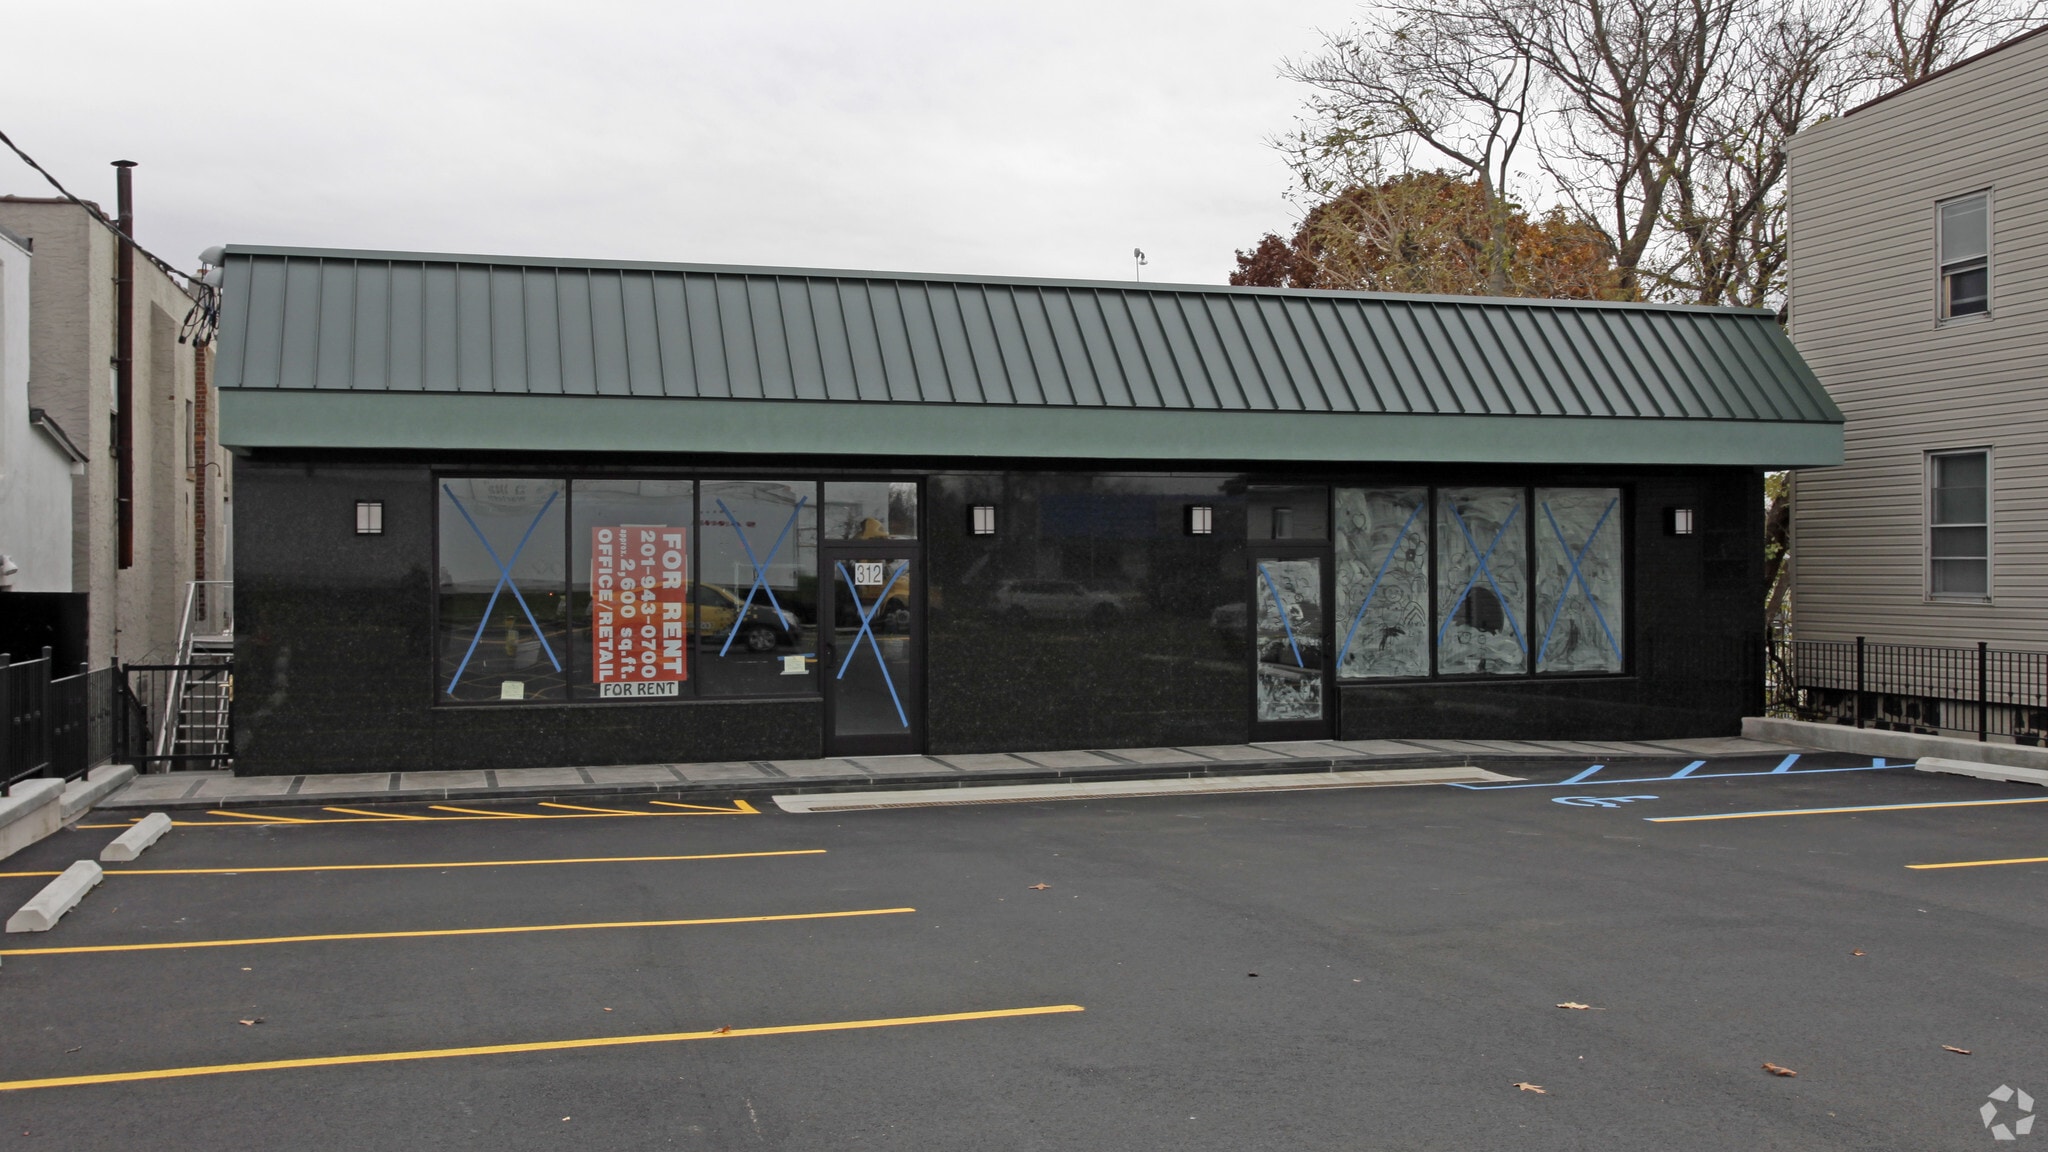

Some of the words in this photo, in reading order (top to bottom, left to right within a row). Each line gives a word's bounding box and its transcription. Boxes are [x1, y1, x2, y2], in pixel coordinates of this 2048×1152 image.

[619, 529, 627, 557] approx.
[662, 534, 682, 589] FOR
[617, 559, 636, 618] 2,600
[857, 565, 881, 583] 312
[597, 529, 613, 681] OFFICE/RETAIL
[641, 530, 656, 678] 201-943-0700
[618, 627, 637, 679] sq.ft.
[662, 602, 682, 674] RENT
[604, 684, 632, 696] FOR
[637, 682, 675, 695] RENT
